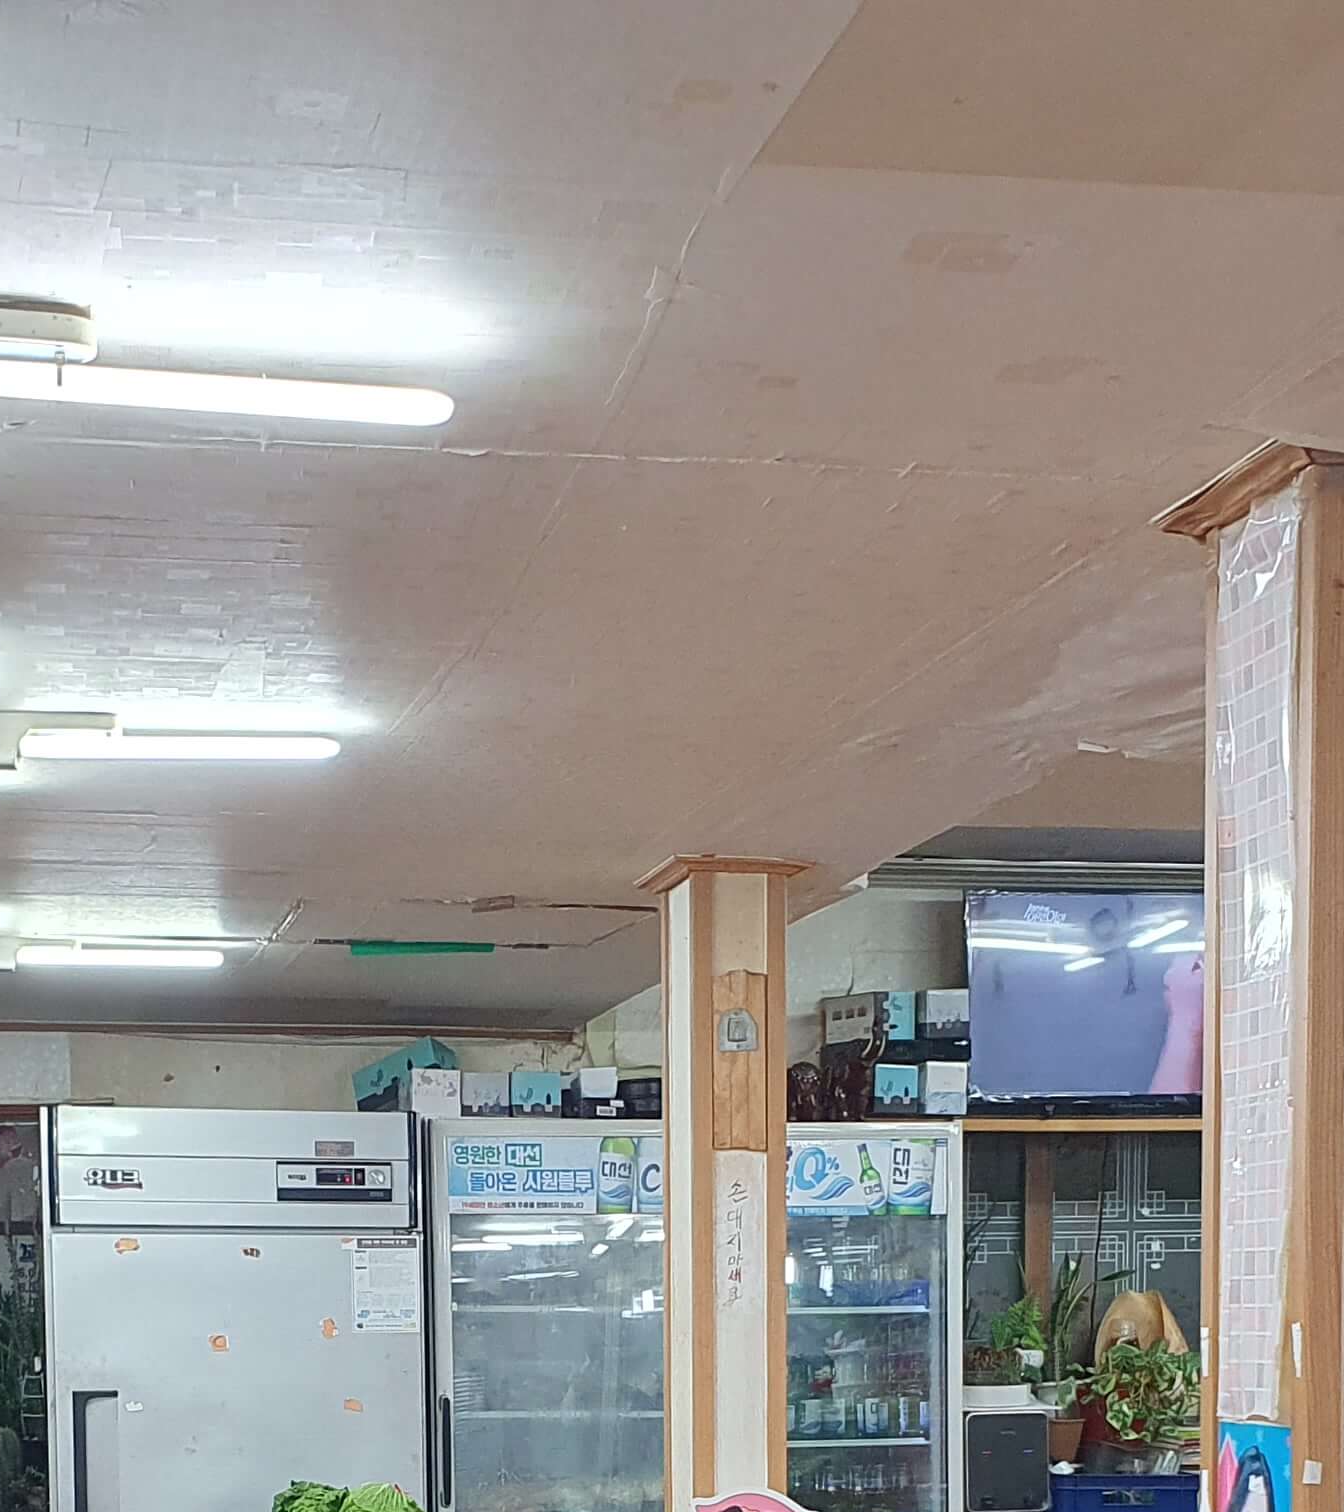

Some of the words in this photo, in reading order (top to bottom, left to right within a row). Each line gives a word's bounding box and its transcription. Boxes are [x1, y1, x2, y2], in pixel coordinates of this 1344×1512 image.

[454, 1145, 501, 1165] 영원한
[508, 1145, 542, 1167] 대선
[601, 1160, 632, 1179] 대선
[469, 1171, 517, 1192] 돌아온
[523, 1170, 594, 1193] 시원블루
